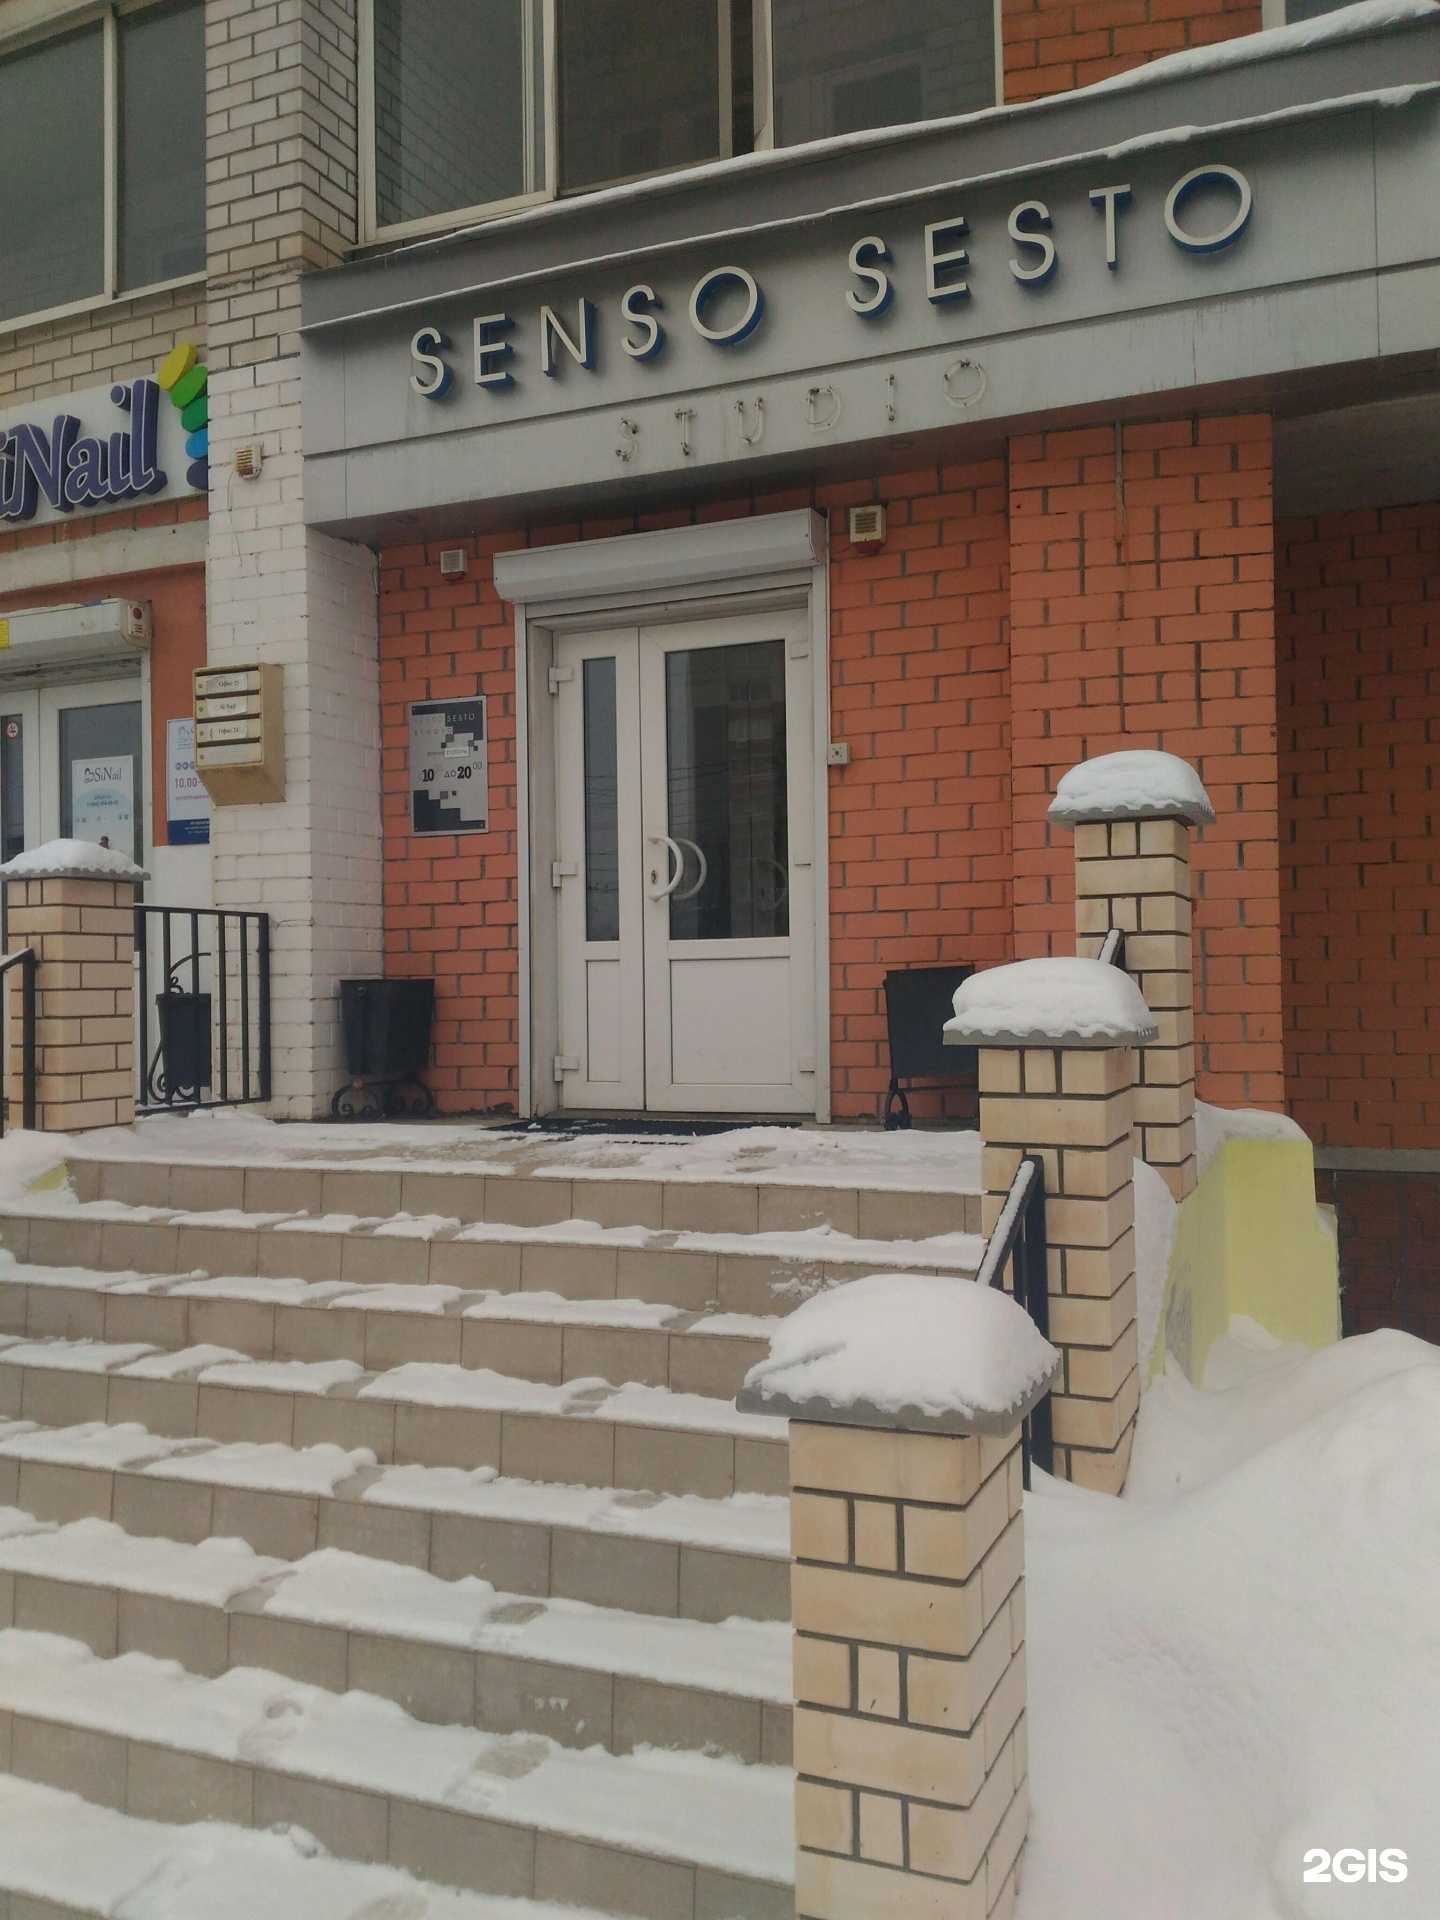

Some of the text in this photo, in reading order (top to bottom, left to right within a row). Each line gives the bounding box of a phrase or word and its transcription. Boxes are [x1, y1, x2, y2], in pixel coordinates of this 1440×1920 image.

[409, 163, 1253, 400] SENSO SESTO
[615, 358, 988, 463] STUDIO
[422, 768, 434, 782] 10
[457, 765, 472, 779] 20
